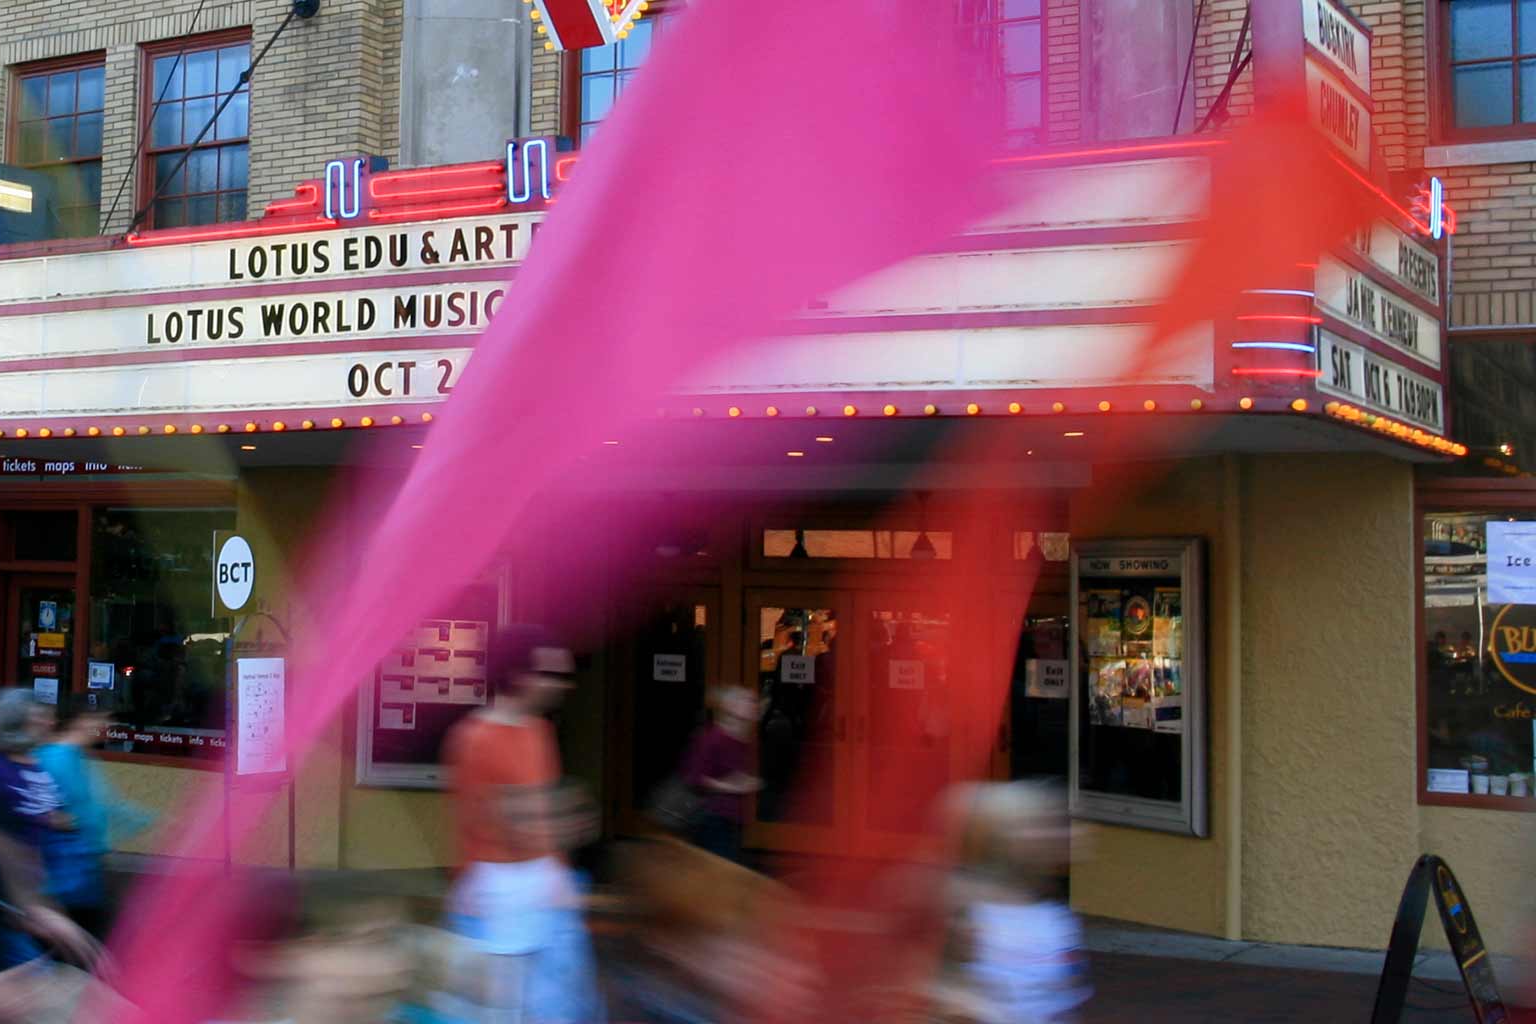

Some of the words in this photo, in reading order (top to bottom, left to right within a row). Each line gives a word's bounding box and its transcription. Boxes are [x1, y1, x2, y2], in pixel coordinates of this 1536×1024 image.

[229, 239, 330, 281] LOTUS
[343, 233, 409, 272] EDU
[420, 231, 441, 265] &
[449, 223, 520, 263] ART
[1398, 239, 1437, 299] PRESENTS
[146, 306, 245, 345] LOTUS
[261, 297, 376, 337] WORLD
[394, 288, 505, 330] MUSIC
[347, 361, 417, 398] OCT
[1331, 344, 1352, 391] SAT
[1364, 359, 1381, 400] OCT
[3, 457, 36, 472] tickets
[44, 460, 75, 475] maps
[1119, 559, 1169, 570] SHOWING
[1506, 555, 1531, 567] Ice
[218, 562, 252, 584] BCT
[1045, 665, 1064, 676] Exit
[106, 729, 129, 740] tickets
[160, 733, 183, 744] tickets
[189, 736, 204, 746] info
